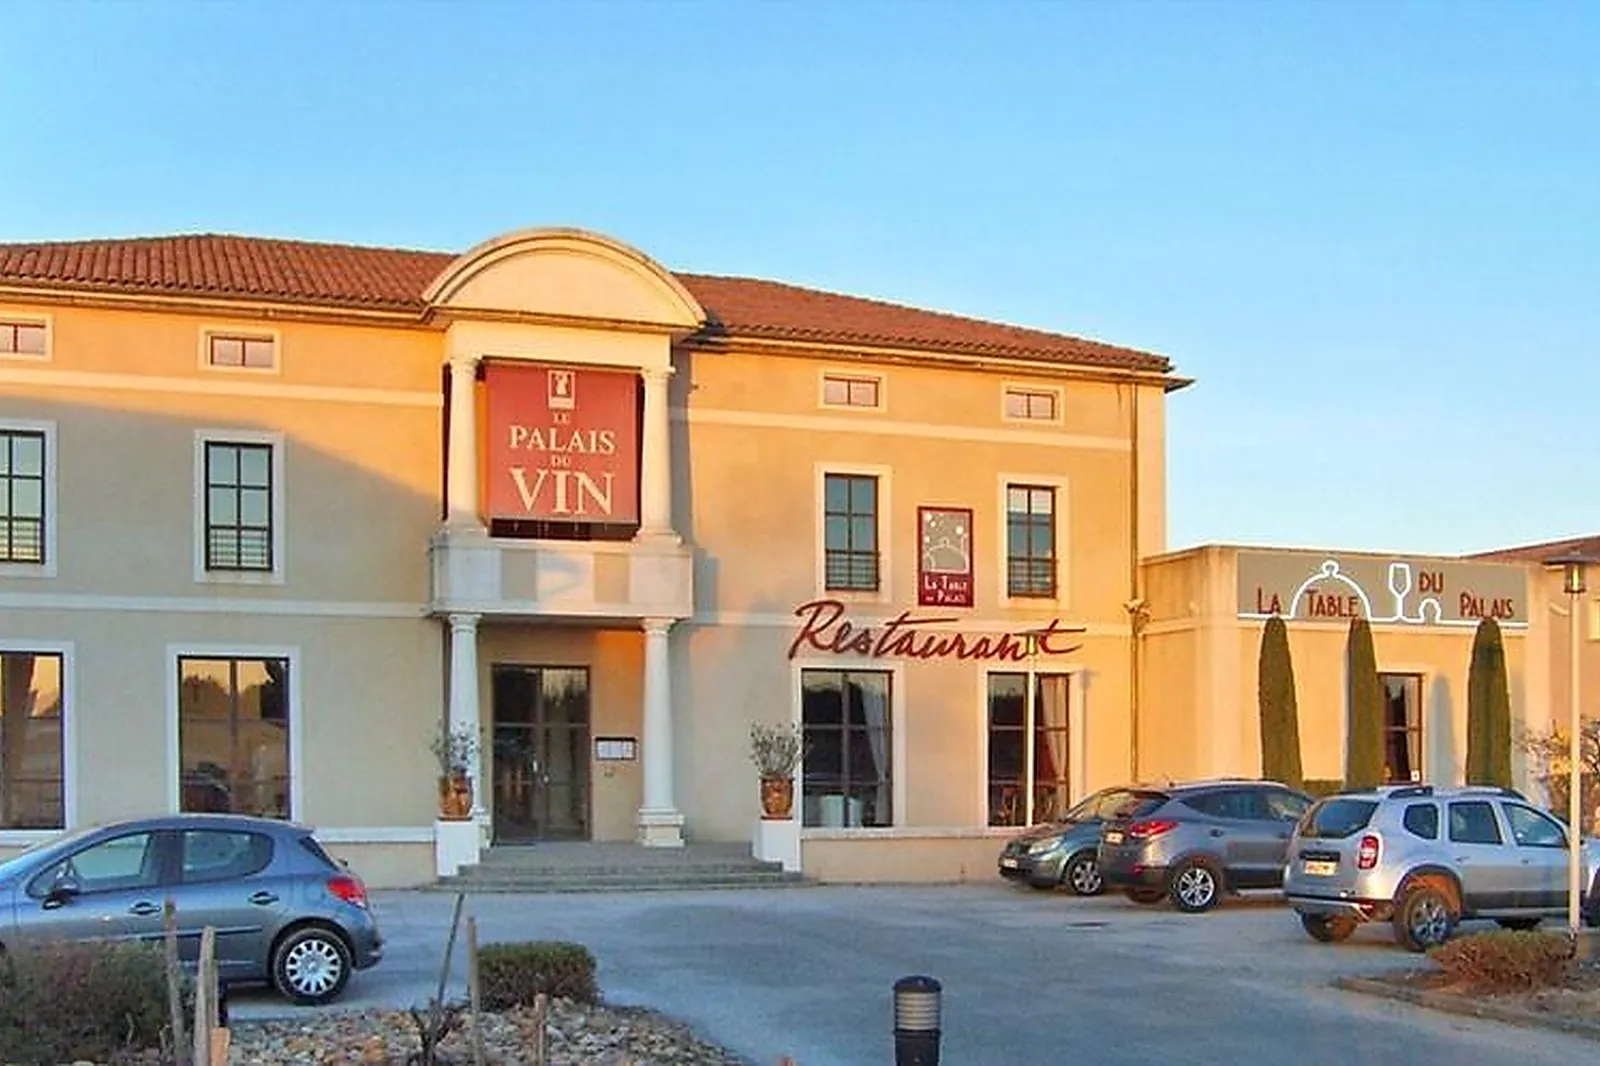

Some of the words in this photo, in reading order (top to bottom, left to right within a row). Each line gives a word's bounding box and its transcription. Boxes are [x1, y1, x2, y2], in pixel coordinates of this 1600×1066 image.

[509, 424, 616, 454] PALAIS
[553, 412, 570, 424] LE
[509, 467, 615, 515] VIN
[1258, 588, 1281, 614] LA
[1305, 589, 1358, 617] TABLE
[1419, 572, 1443, 593] DU
[1460, 592, 1513, 619] PALAIS
[789, 600, 1087, 661] Restaurant
